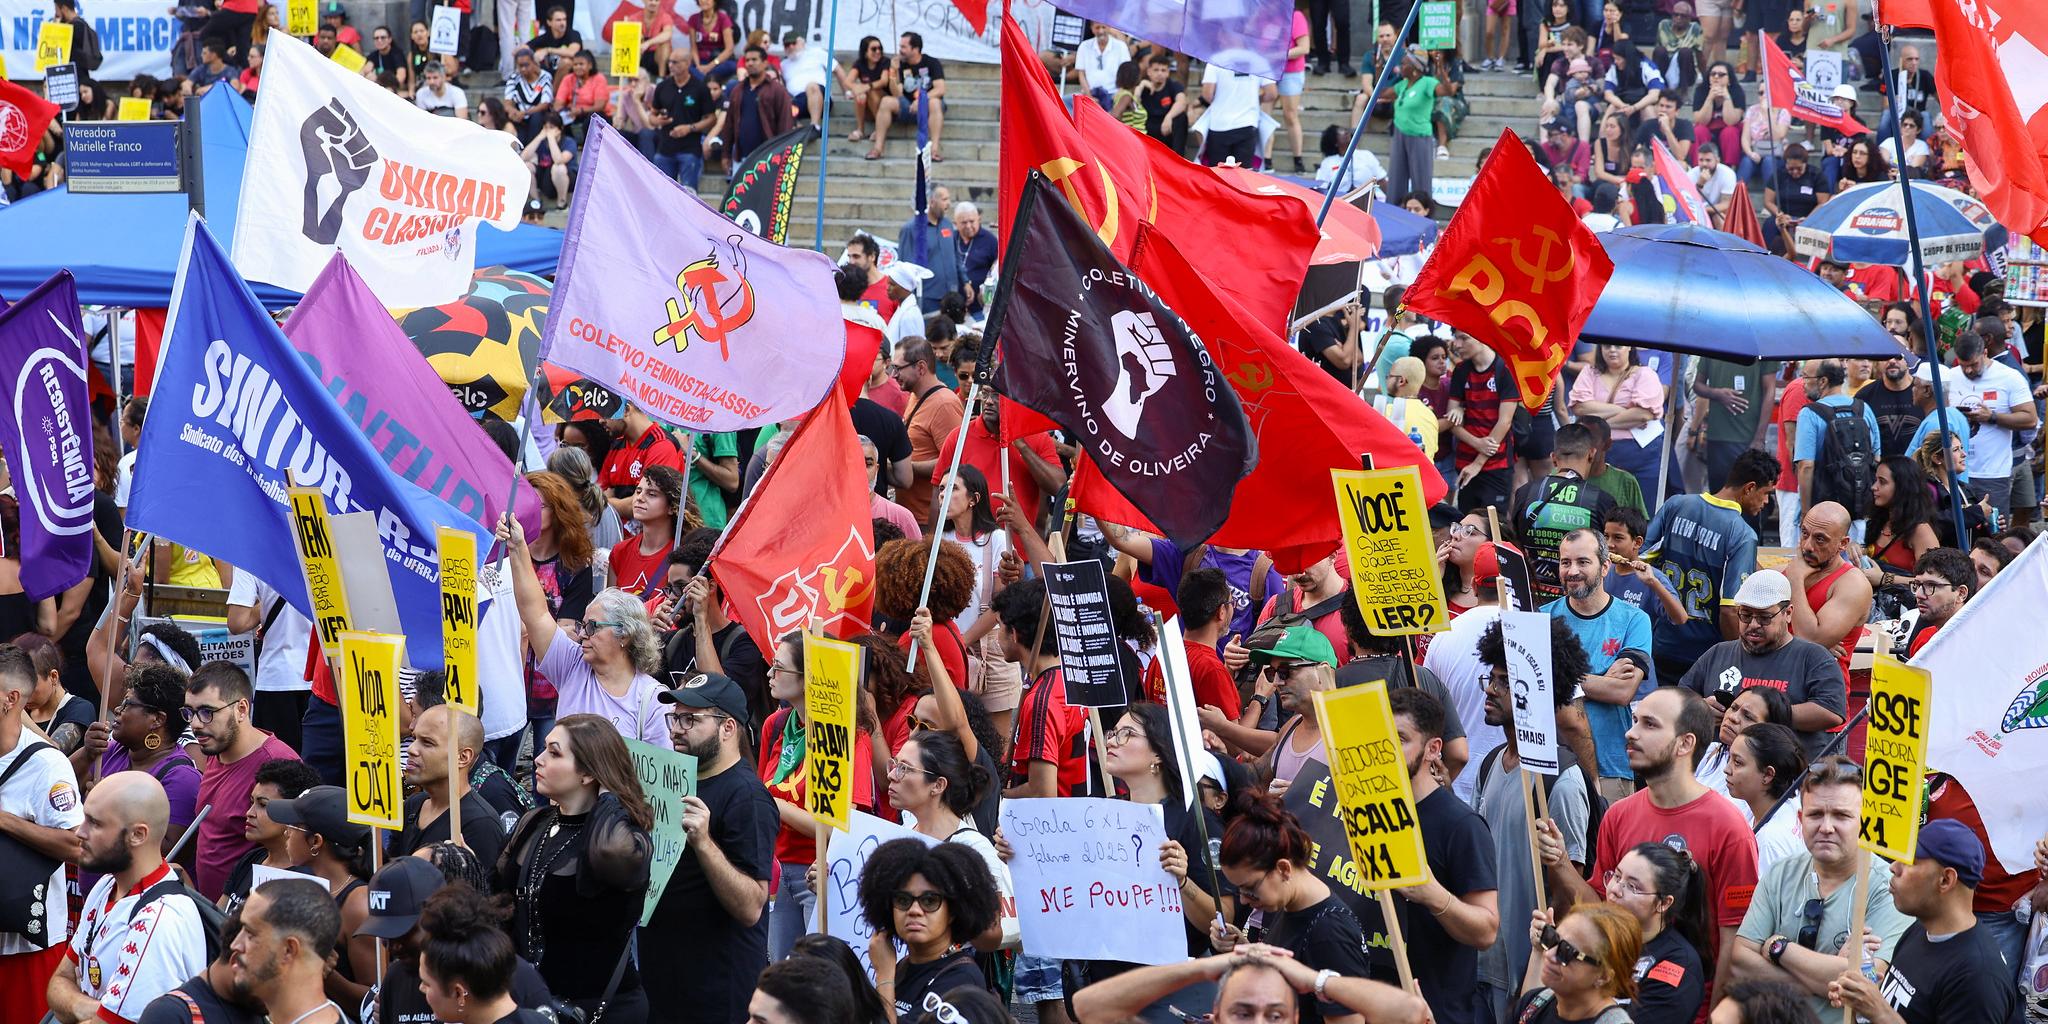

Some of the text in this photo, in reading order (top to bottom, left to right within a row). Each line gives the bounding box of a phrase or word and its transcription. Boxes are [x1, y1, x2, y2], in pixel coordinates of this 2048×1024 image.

[68, 127, 116, 138] Vereadora
[70, 141, 142, 152] Marielle Franco
[380, 157, 506, 222] UNIDADE
[1856, 216, 1898, 228] BRAHMA
[1924, 246, 1944, 256] CHOPP
[1946, 244, 1952, 253] DE
[569, 317, 645, 368] COLETIVO
[1177, 316, 1216, 403] NEGRO
[584, 386, 609, 408] elo
[1063, 309, 1212, 476] MINERVINO DE OLIVEIRA
[39, 362, 95, 504] RESISTÊNCIA
[48, 436, 59, 467] PSOL
[179, 422, 224, 454] Sindicato
[222, 442, 245, 466] dos
[386, 548, 402, 563] da
[403, 556, 440, 584] UFRRJ
[1346, 482, 1410, 535] VOCÊ
[1552, 512, 1585, 526] CARD
[1672, 516, 1722, 551] NEW YORK
[1369, 554, 1396, 568] QUE
[1377, 570, 1400, 582] VER
[1400, 568, 1425, 581] SEU
[1075, 592, 1103, 605] INIMIGA
[1368, 580, 1430, 594] SEU FILHO
[1623, 590, 1643, 602] Good
[442, 592, 474, 631] RAIS
[1373, 604, 1435, 632] LER?
[1082, 623, 1109, 636] INIMIGA
[200, 640, 250, 651] EITAMOS
[1507, 638, 1517, 650] FIM
[1517, 644, 1526, 658] DA
[1525, 653, 1541, 680] ESCALA
[1088, 654, 1115, 667] INIMIGA
[352, 650, 387, 718] VIDA
[1516, 729, 1546, 746] EMAIS!
[354, 759, 391, 820] JÁ!
[662, 763, 690, 797] MAIS
[1309, 776, 1331, 808] É
[1006, 808, 1077, 836] Escala
[1084, 806, 1094, 829] 6
[1117, 812, 1127, 829] 1
[1881, 802, 1903, 818] DA
[1028, 842, 1070, 875] pleno
[1040, 886, 1074, 913] ME
[1089, 881, 1181, 913] POUPE!!!
[398, 1014, 411, 1022] VIDA
[412, 1012, 430, 1022] ALÉM
